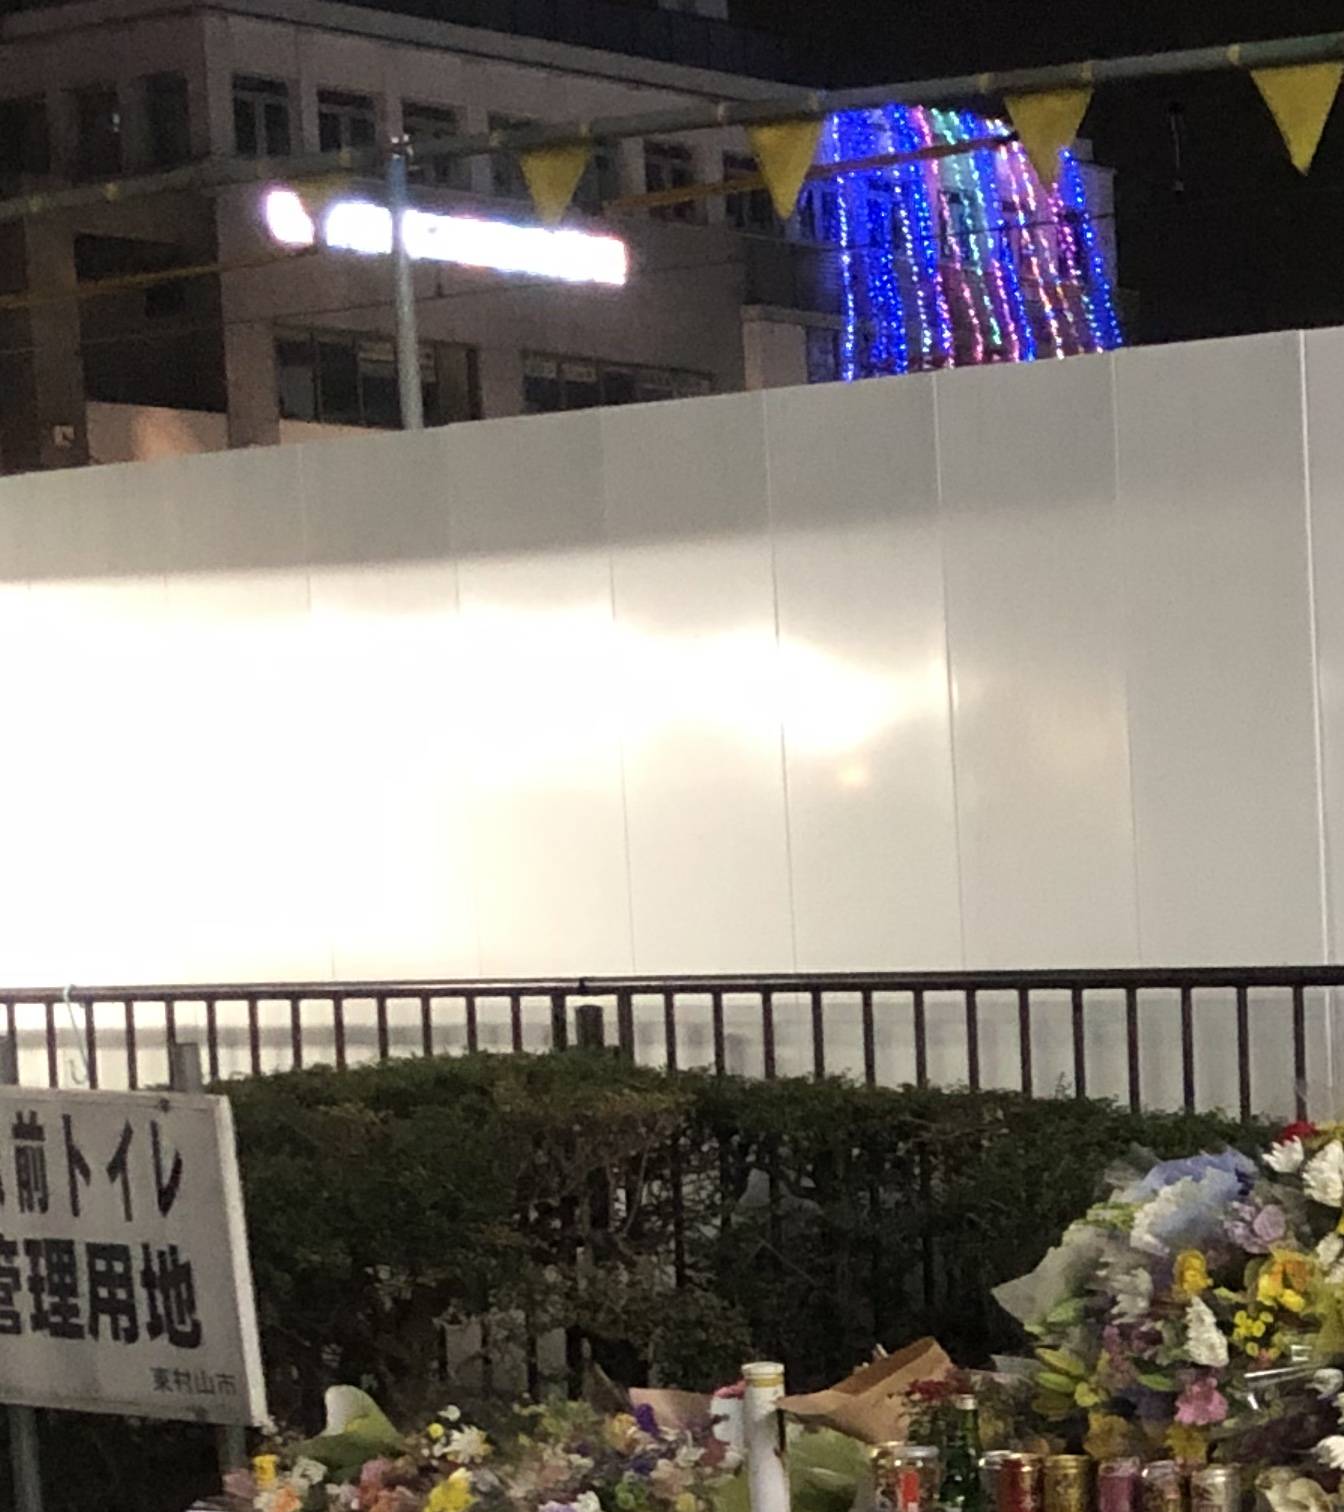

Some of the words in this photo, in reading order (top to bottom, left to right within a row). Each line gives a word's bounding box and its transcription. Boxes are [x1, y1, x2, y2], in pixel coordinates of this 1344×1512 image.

[0, 1108, 184, 1223] 前トイレ
[149, 1366, 237, 1397] 東村山市
